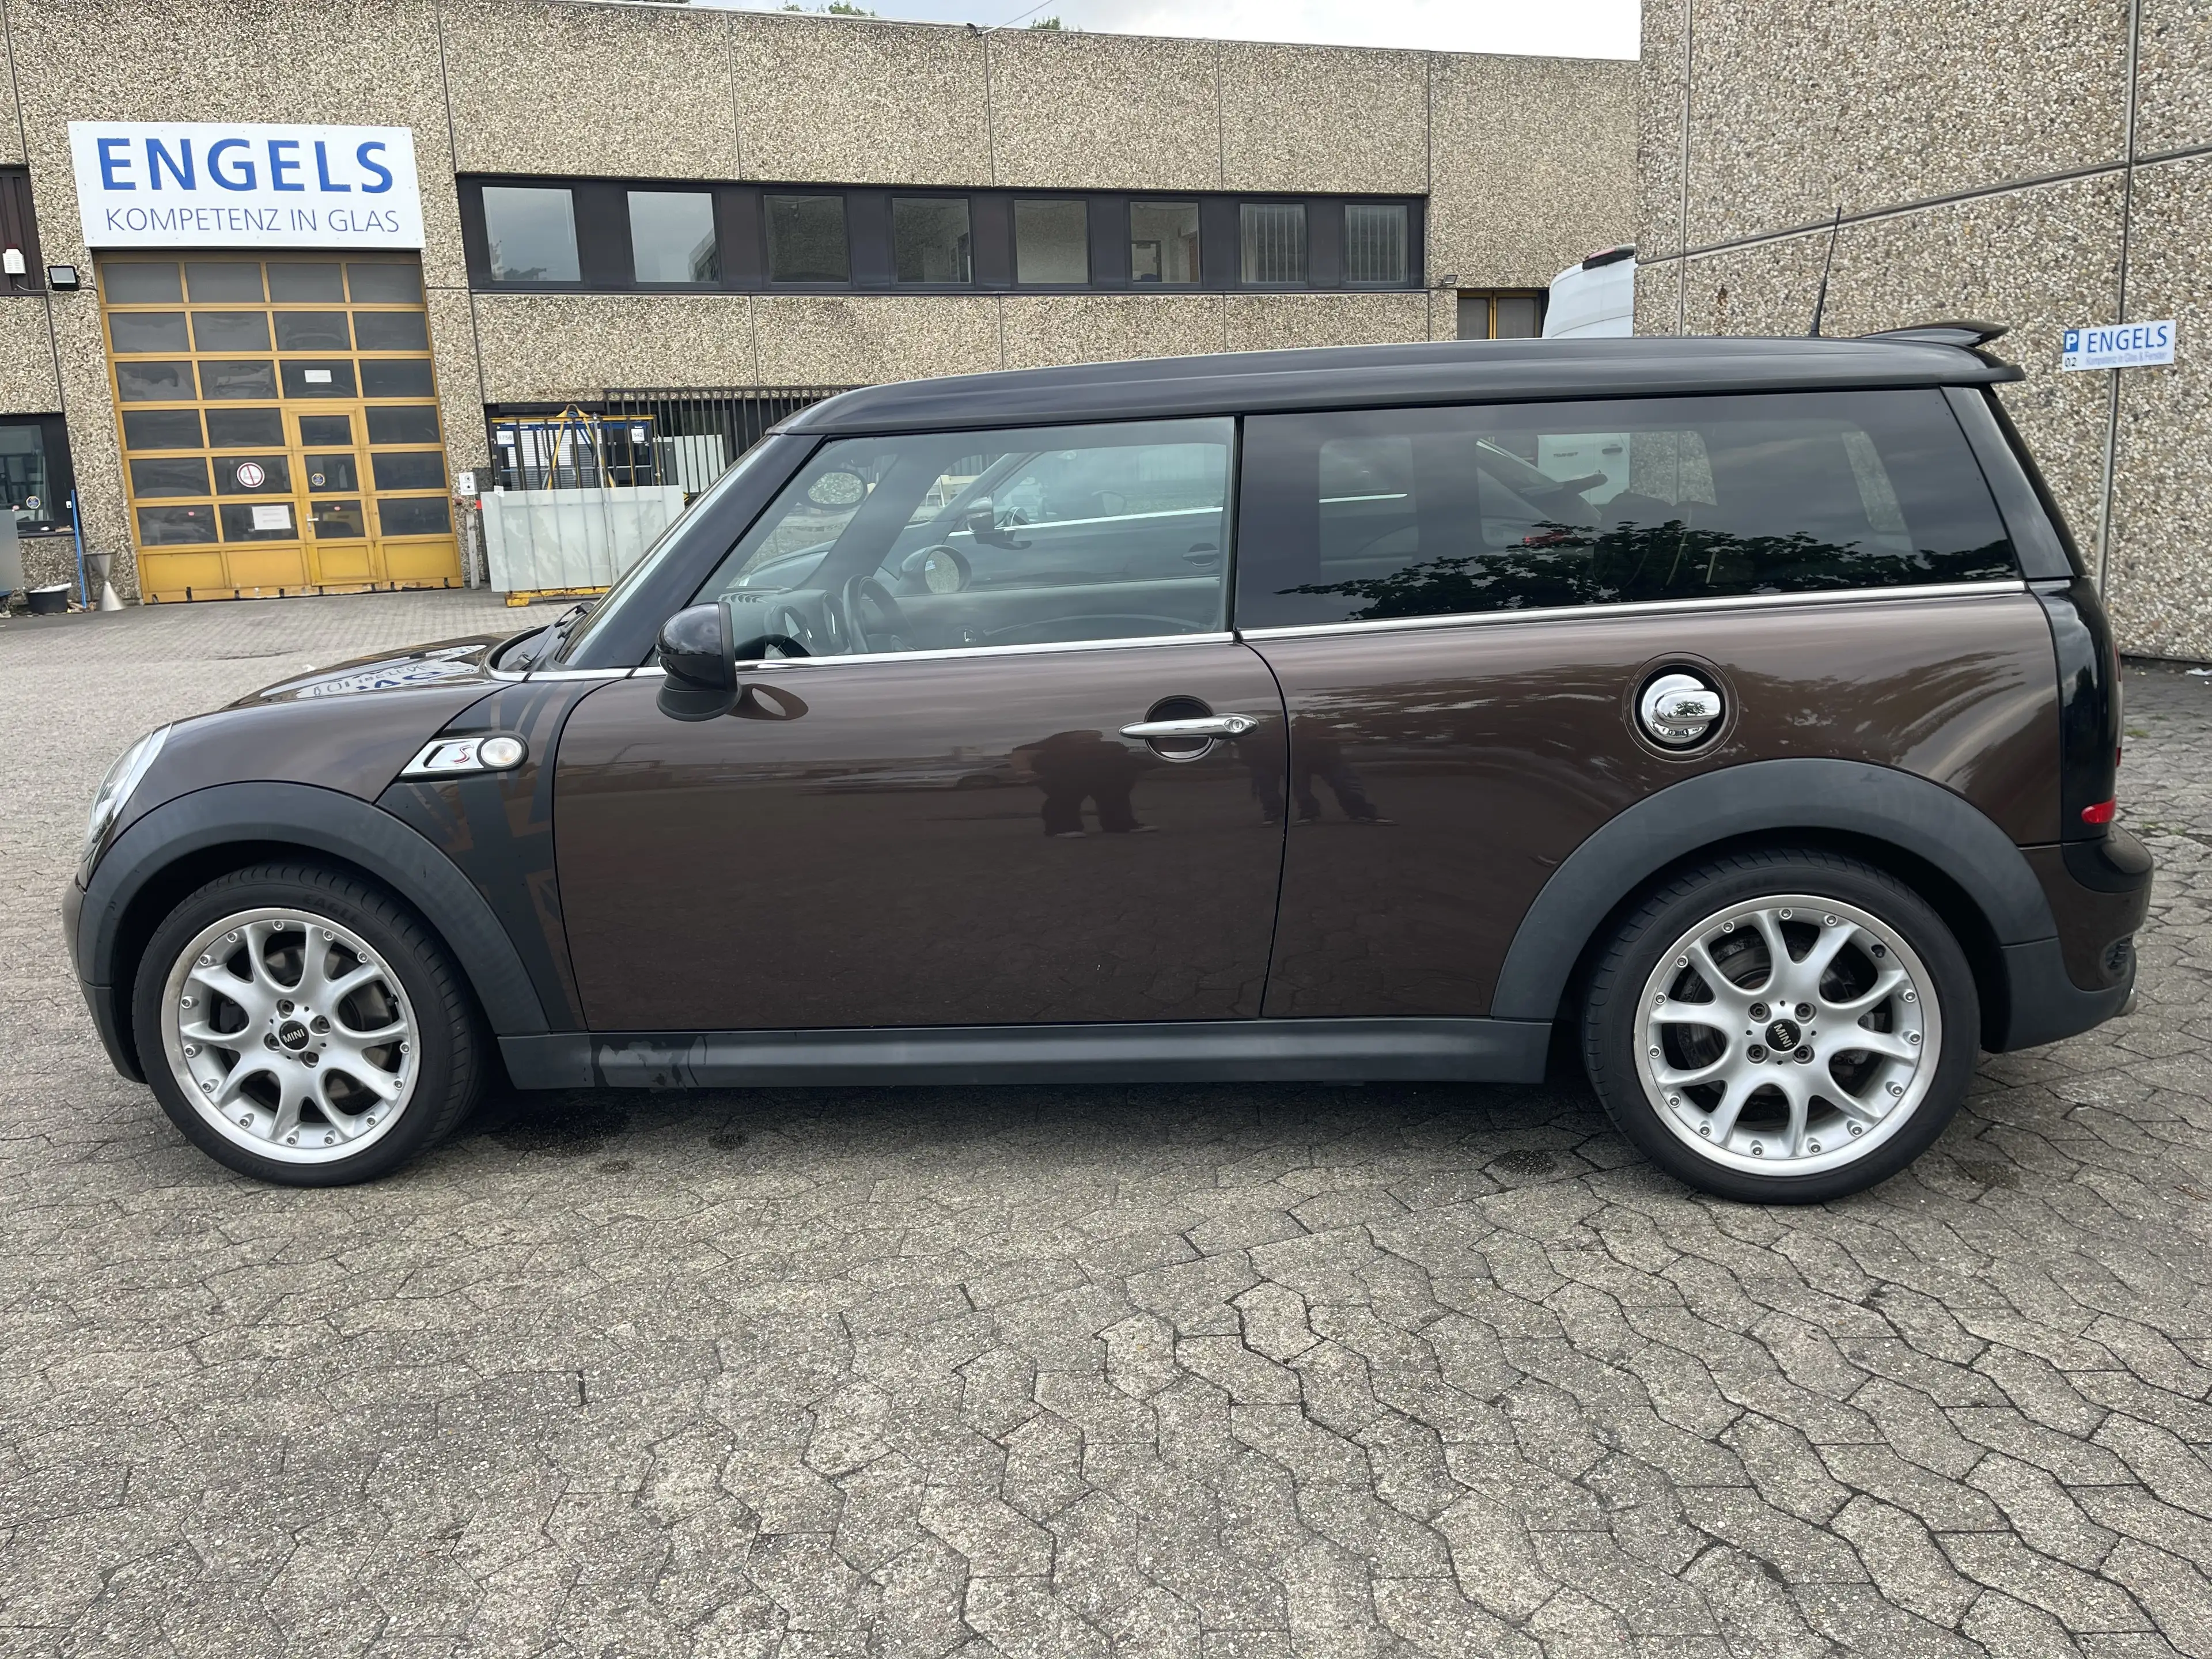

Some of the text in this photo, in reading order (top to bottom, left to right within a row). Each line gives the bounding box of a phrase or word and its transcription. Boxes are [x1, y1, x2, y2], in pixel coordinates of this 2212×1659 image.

[97, 138, 393, 193] ENGELS
[106, 208, 399, 232] KOMPETENZ IN GLAS
[2066, 332, 2078, 350] P
[2088, 325, 2167, 353] ENGELS
[2065, 357, 2077, 367] 02
[452, 745, 474, 764] S
[303, 895, 358, 925] EAGLE
[282, 1029, 305, 1043] MINI
[1774, 1024, 1793, 1047] MINI
